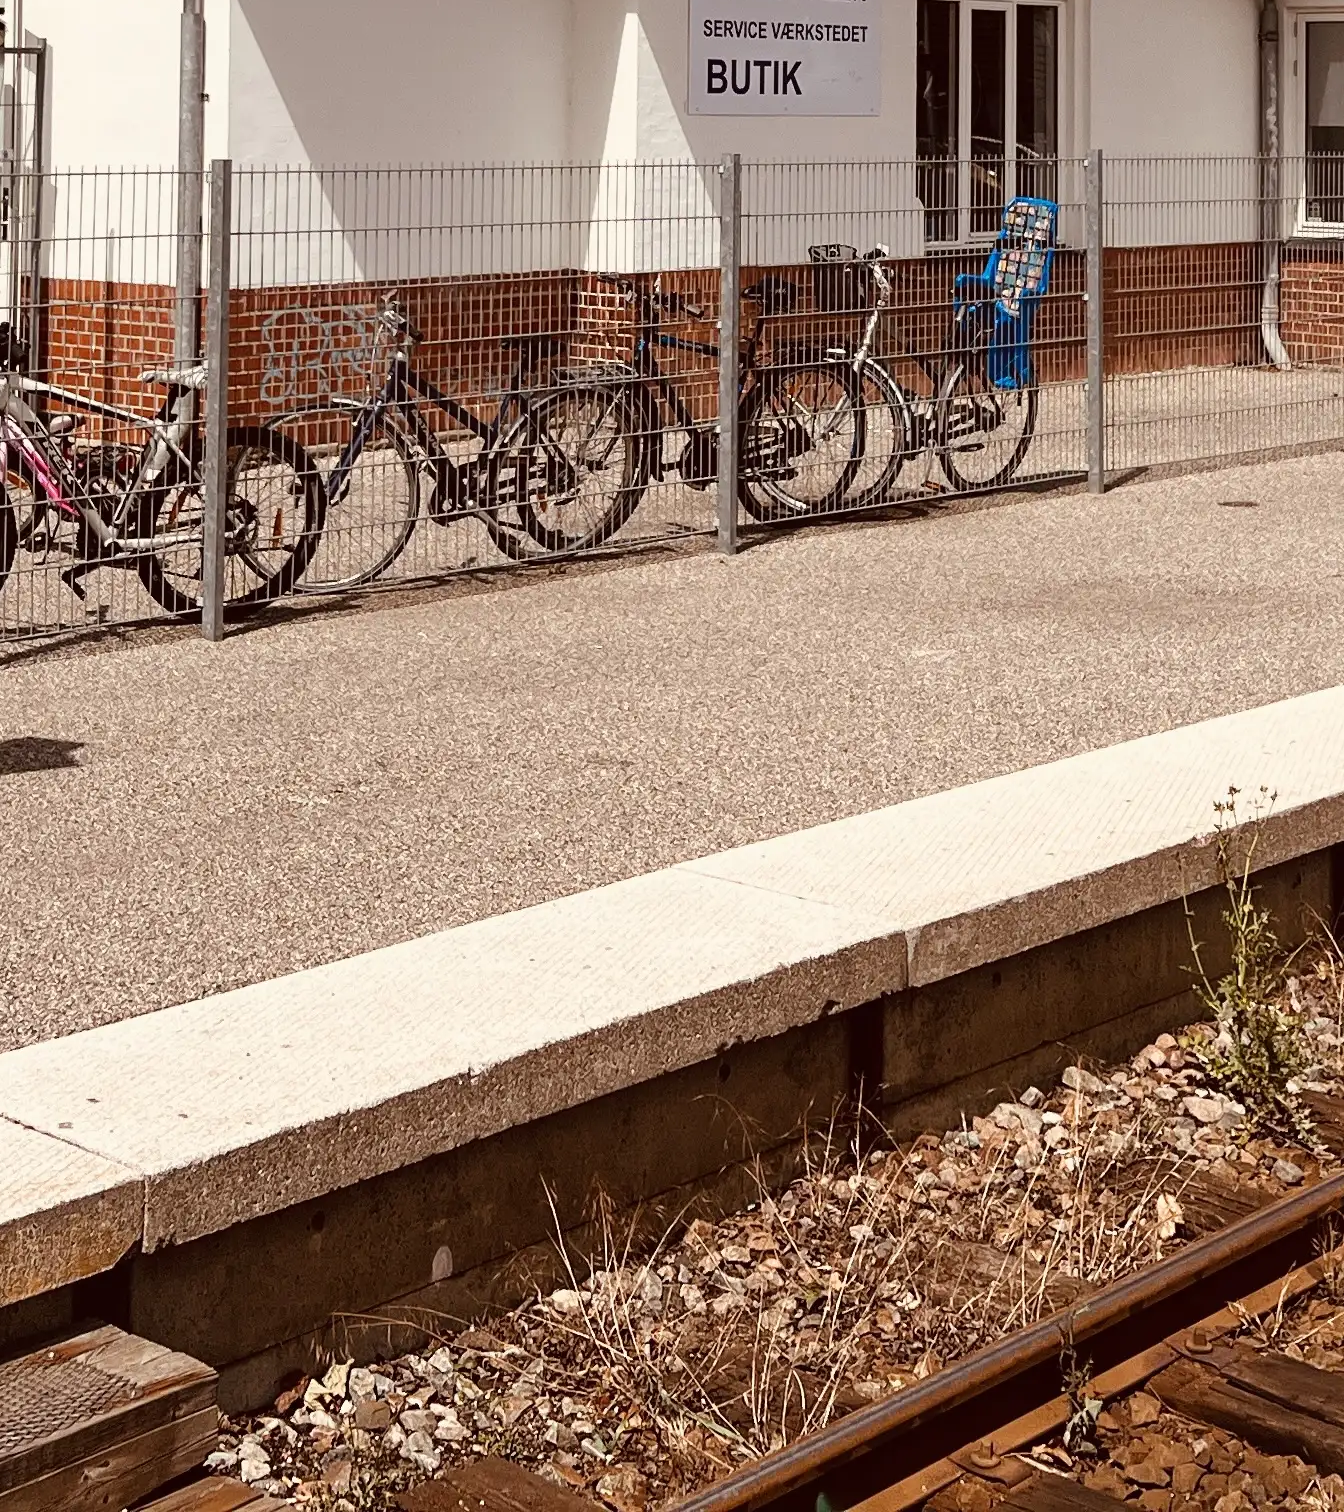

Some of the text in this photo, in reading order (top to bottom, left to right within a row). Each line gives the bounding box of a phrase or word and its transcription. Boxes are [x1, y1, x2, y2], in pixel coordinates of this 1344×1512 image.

[703, 19, 868, 42] SERVICE VÆRKSTEDET
[706, 59, 802, 95] BUTIK
